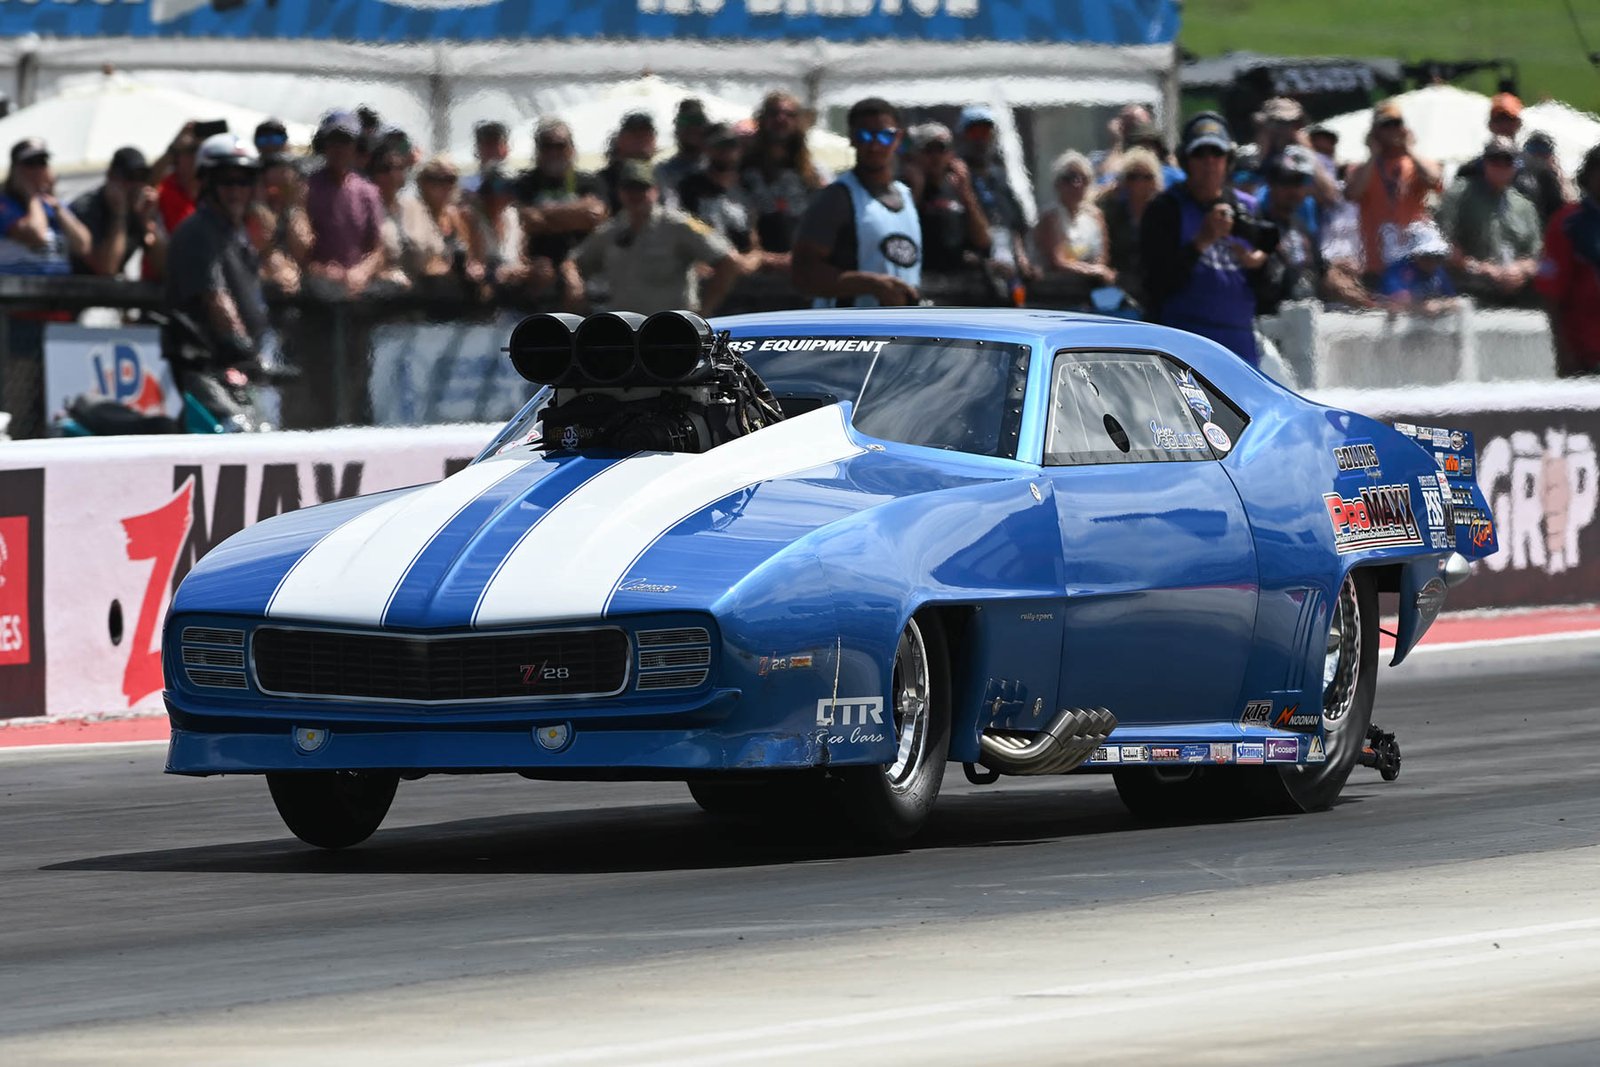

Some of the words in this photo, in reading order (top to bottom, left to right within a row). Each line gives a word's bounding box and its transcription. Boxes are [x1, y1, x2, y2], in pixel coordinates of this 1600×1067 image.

[758, 339, 890, 353] EQUIPMENT
[1160, 432, 1207, 450] COLLINS
[1333, 443, 1380, 472] COLLINS
[1451, 490, 1475, 505] COTT
[1453, 510, 1490, 525] IDWELL
[519, 659, 570, 685] Z/28
[1288, 714, 1320, 726] NOONAN
[815, 728, 845, 744] Rce
[849, 726, 885, 744] Cars
[1275, 746, 1297, 754] HOOSIER
